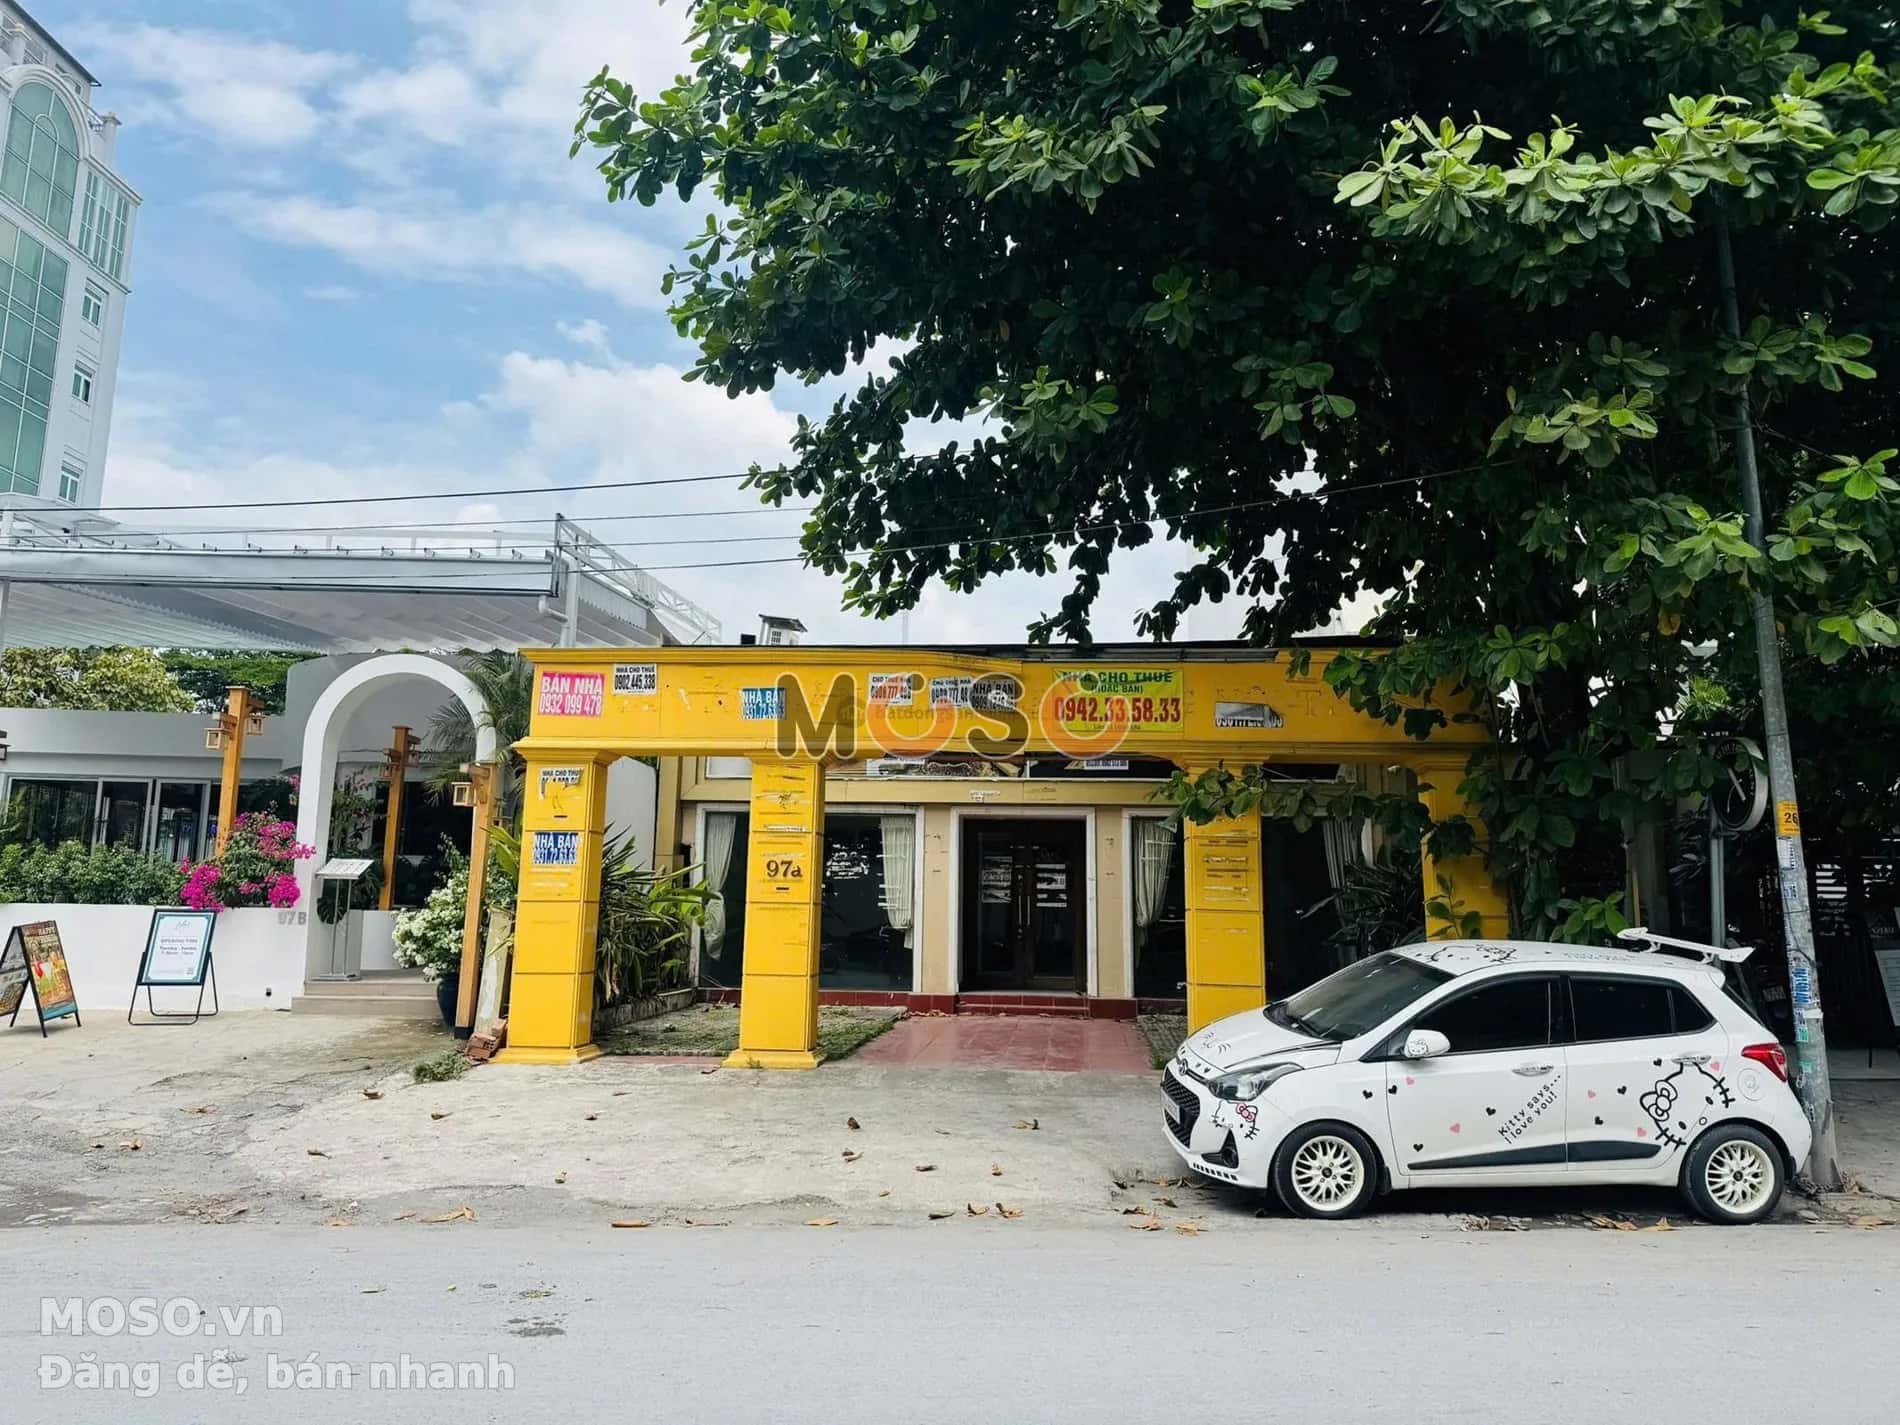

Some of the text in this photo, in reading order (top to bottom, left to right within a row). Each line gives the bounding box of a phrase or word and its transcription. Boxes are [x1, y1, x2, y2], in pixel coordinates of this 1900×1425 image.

[540, 694, 602, 715] 0932 099 478
[765, 860, 803, 878] 97a
[1498, 1109, 1525, 1137] Kitty
[1510, 1116, 1535, 1139] love
[1534, 1090, 1558, 1117] you!
